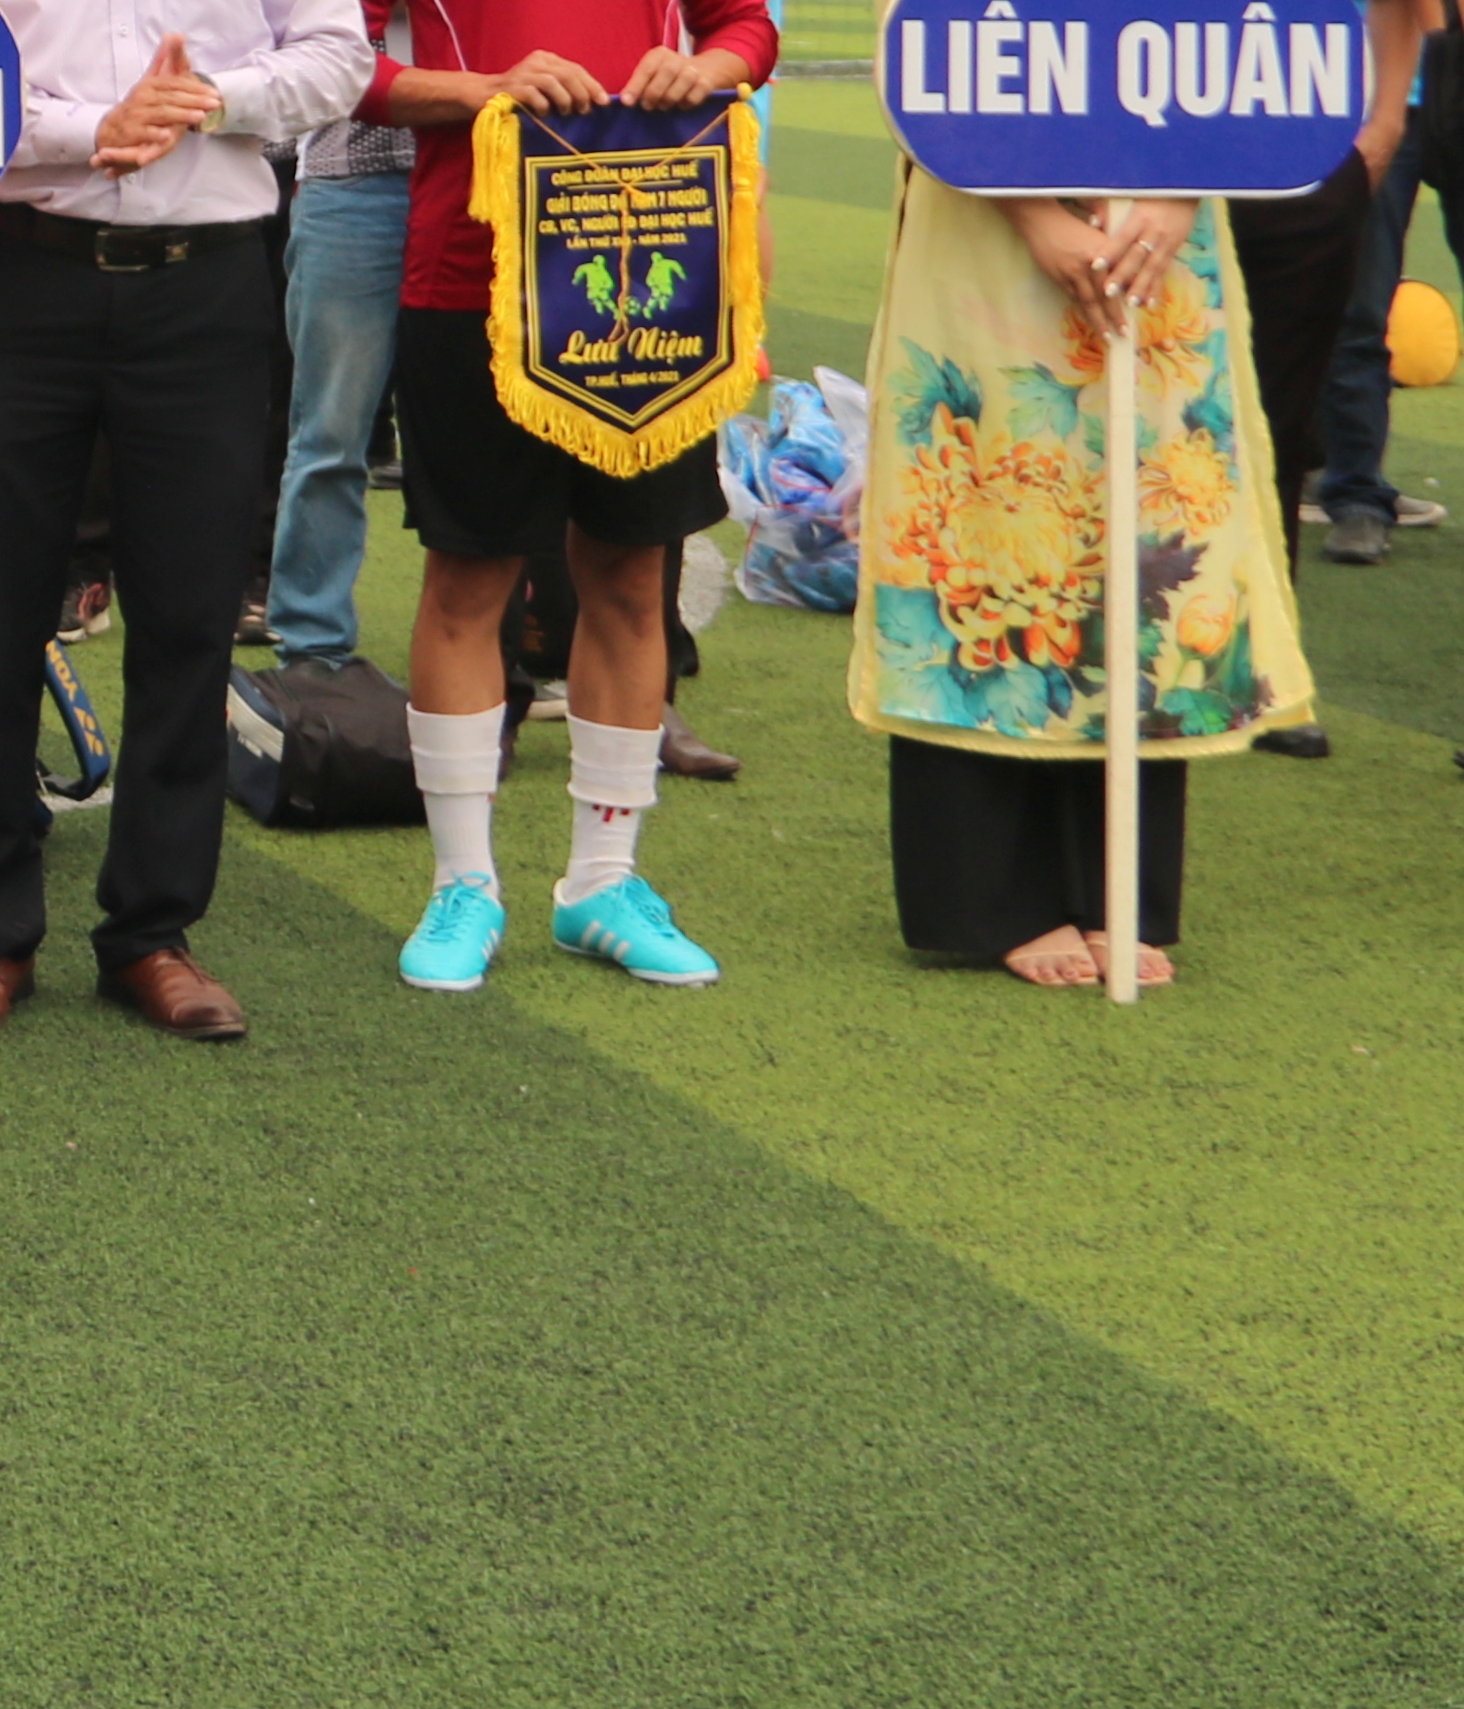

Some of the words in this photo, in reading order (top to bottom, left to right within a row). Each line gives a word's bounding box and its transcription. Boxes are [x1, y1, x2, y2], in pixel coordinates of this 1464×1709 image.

[901, 0, 1088, 114] LIÊN
[1117, 2, 1350, 127] QUÂN
[558, 330, 620, 364] Lưu
[628, 326, 703, 365] Niệm
